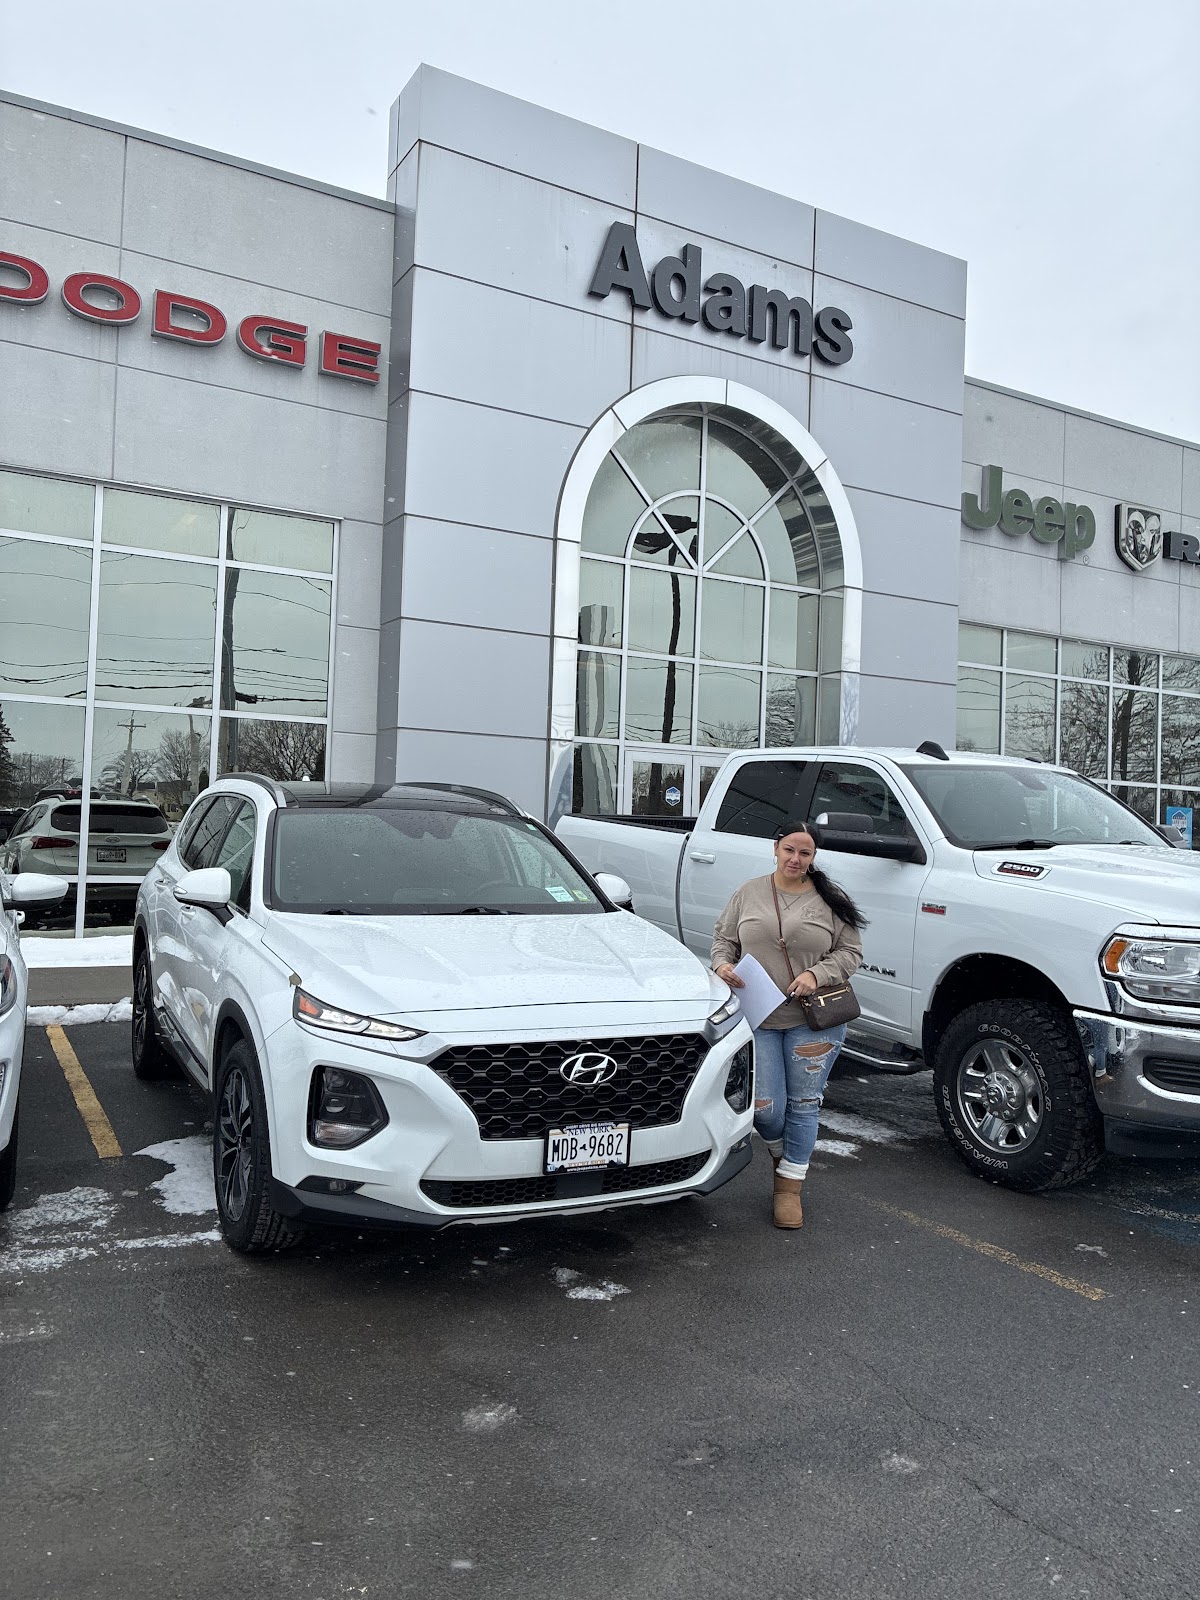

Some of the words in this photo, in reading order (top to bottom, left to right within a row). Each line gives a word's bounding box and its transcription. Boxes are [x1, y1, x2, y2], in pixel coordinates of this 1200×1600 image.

[588, 220, 853, 365] Adams
[961, 464, 1096, 562] Jeep
[1003, 863, 1040, 873] 2500
[977, 1023, 1051, 1112] GOODYEAR
[568, 1128, 587, 1136] NEW
[589, 1126, 610, 1134] YORK
[942, 1085, 1009, 1169] WRANGLER
